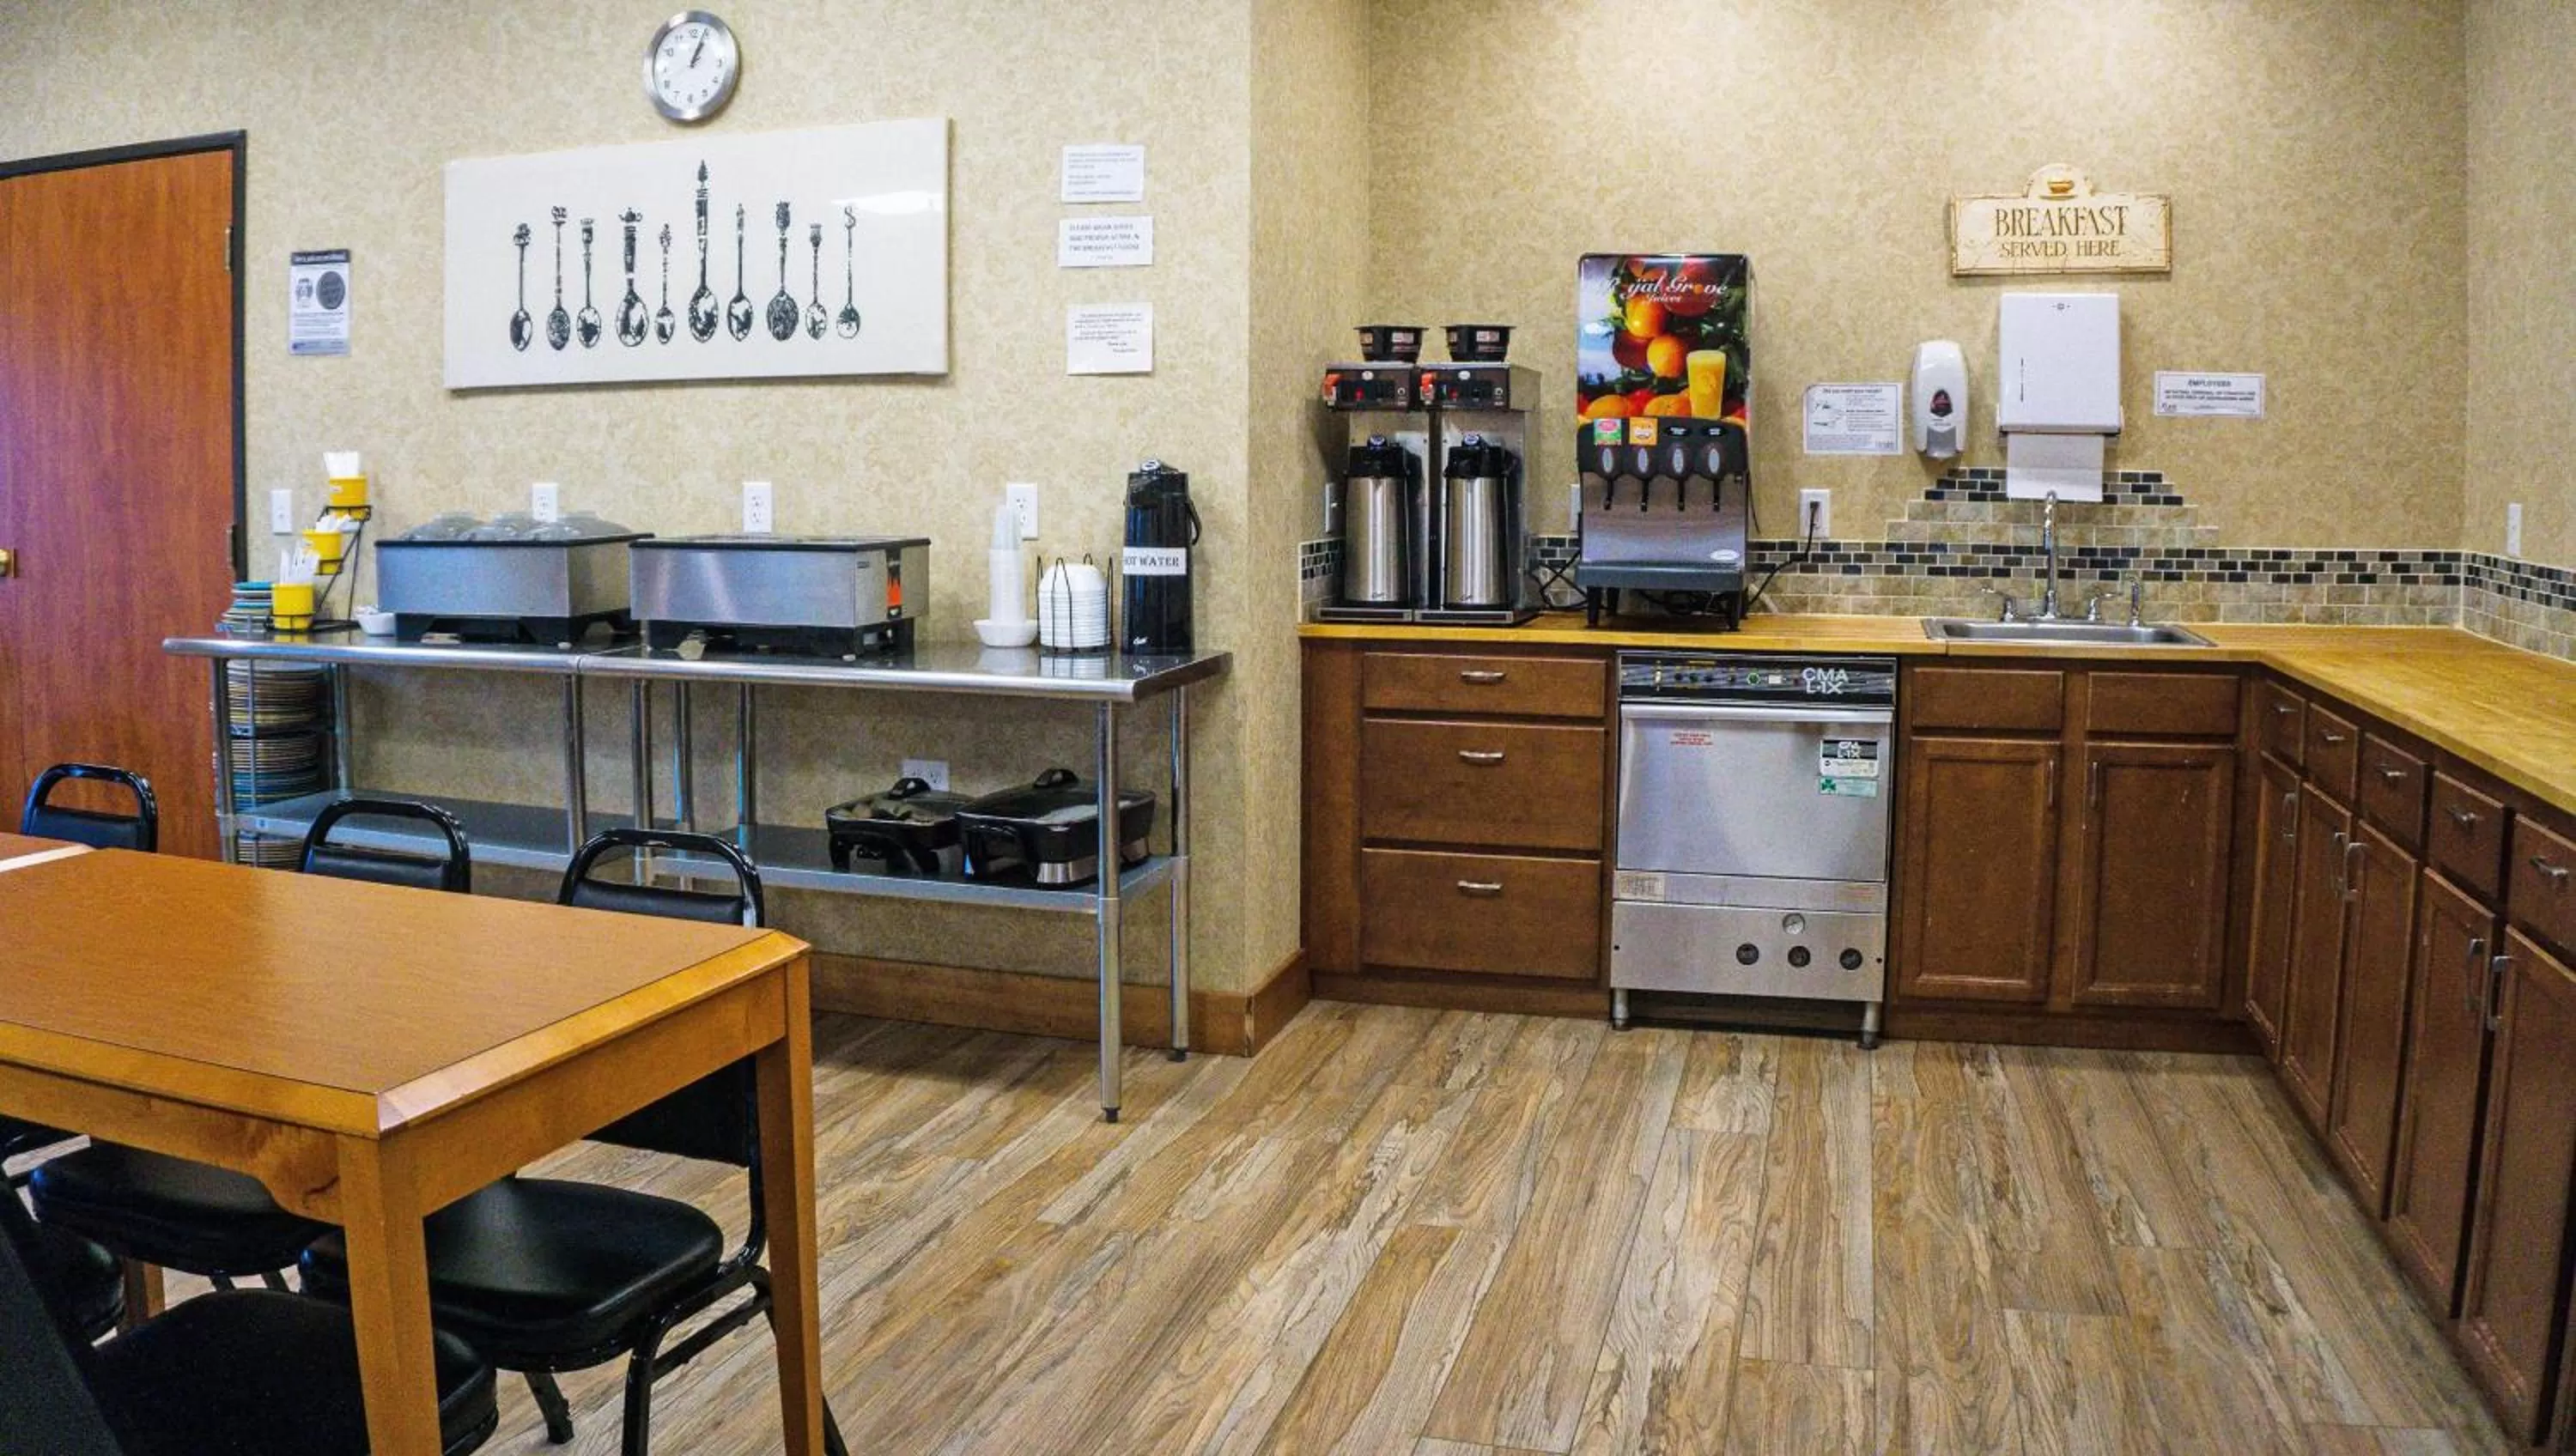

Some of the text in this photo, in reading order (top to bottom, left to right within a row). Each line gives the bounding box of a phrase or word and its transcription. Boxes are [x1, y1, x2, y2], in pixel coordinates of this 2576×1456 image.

[1995, 205, 2129, 237] BREAKFAST
[1999, 240, 2122, 258] SERVED HERE
[1139, 555, 1179, 567] WATER
[1802, 667, 1849, 682] CMA
